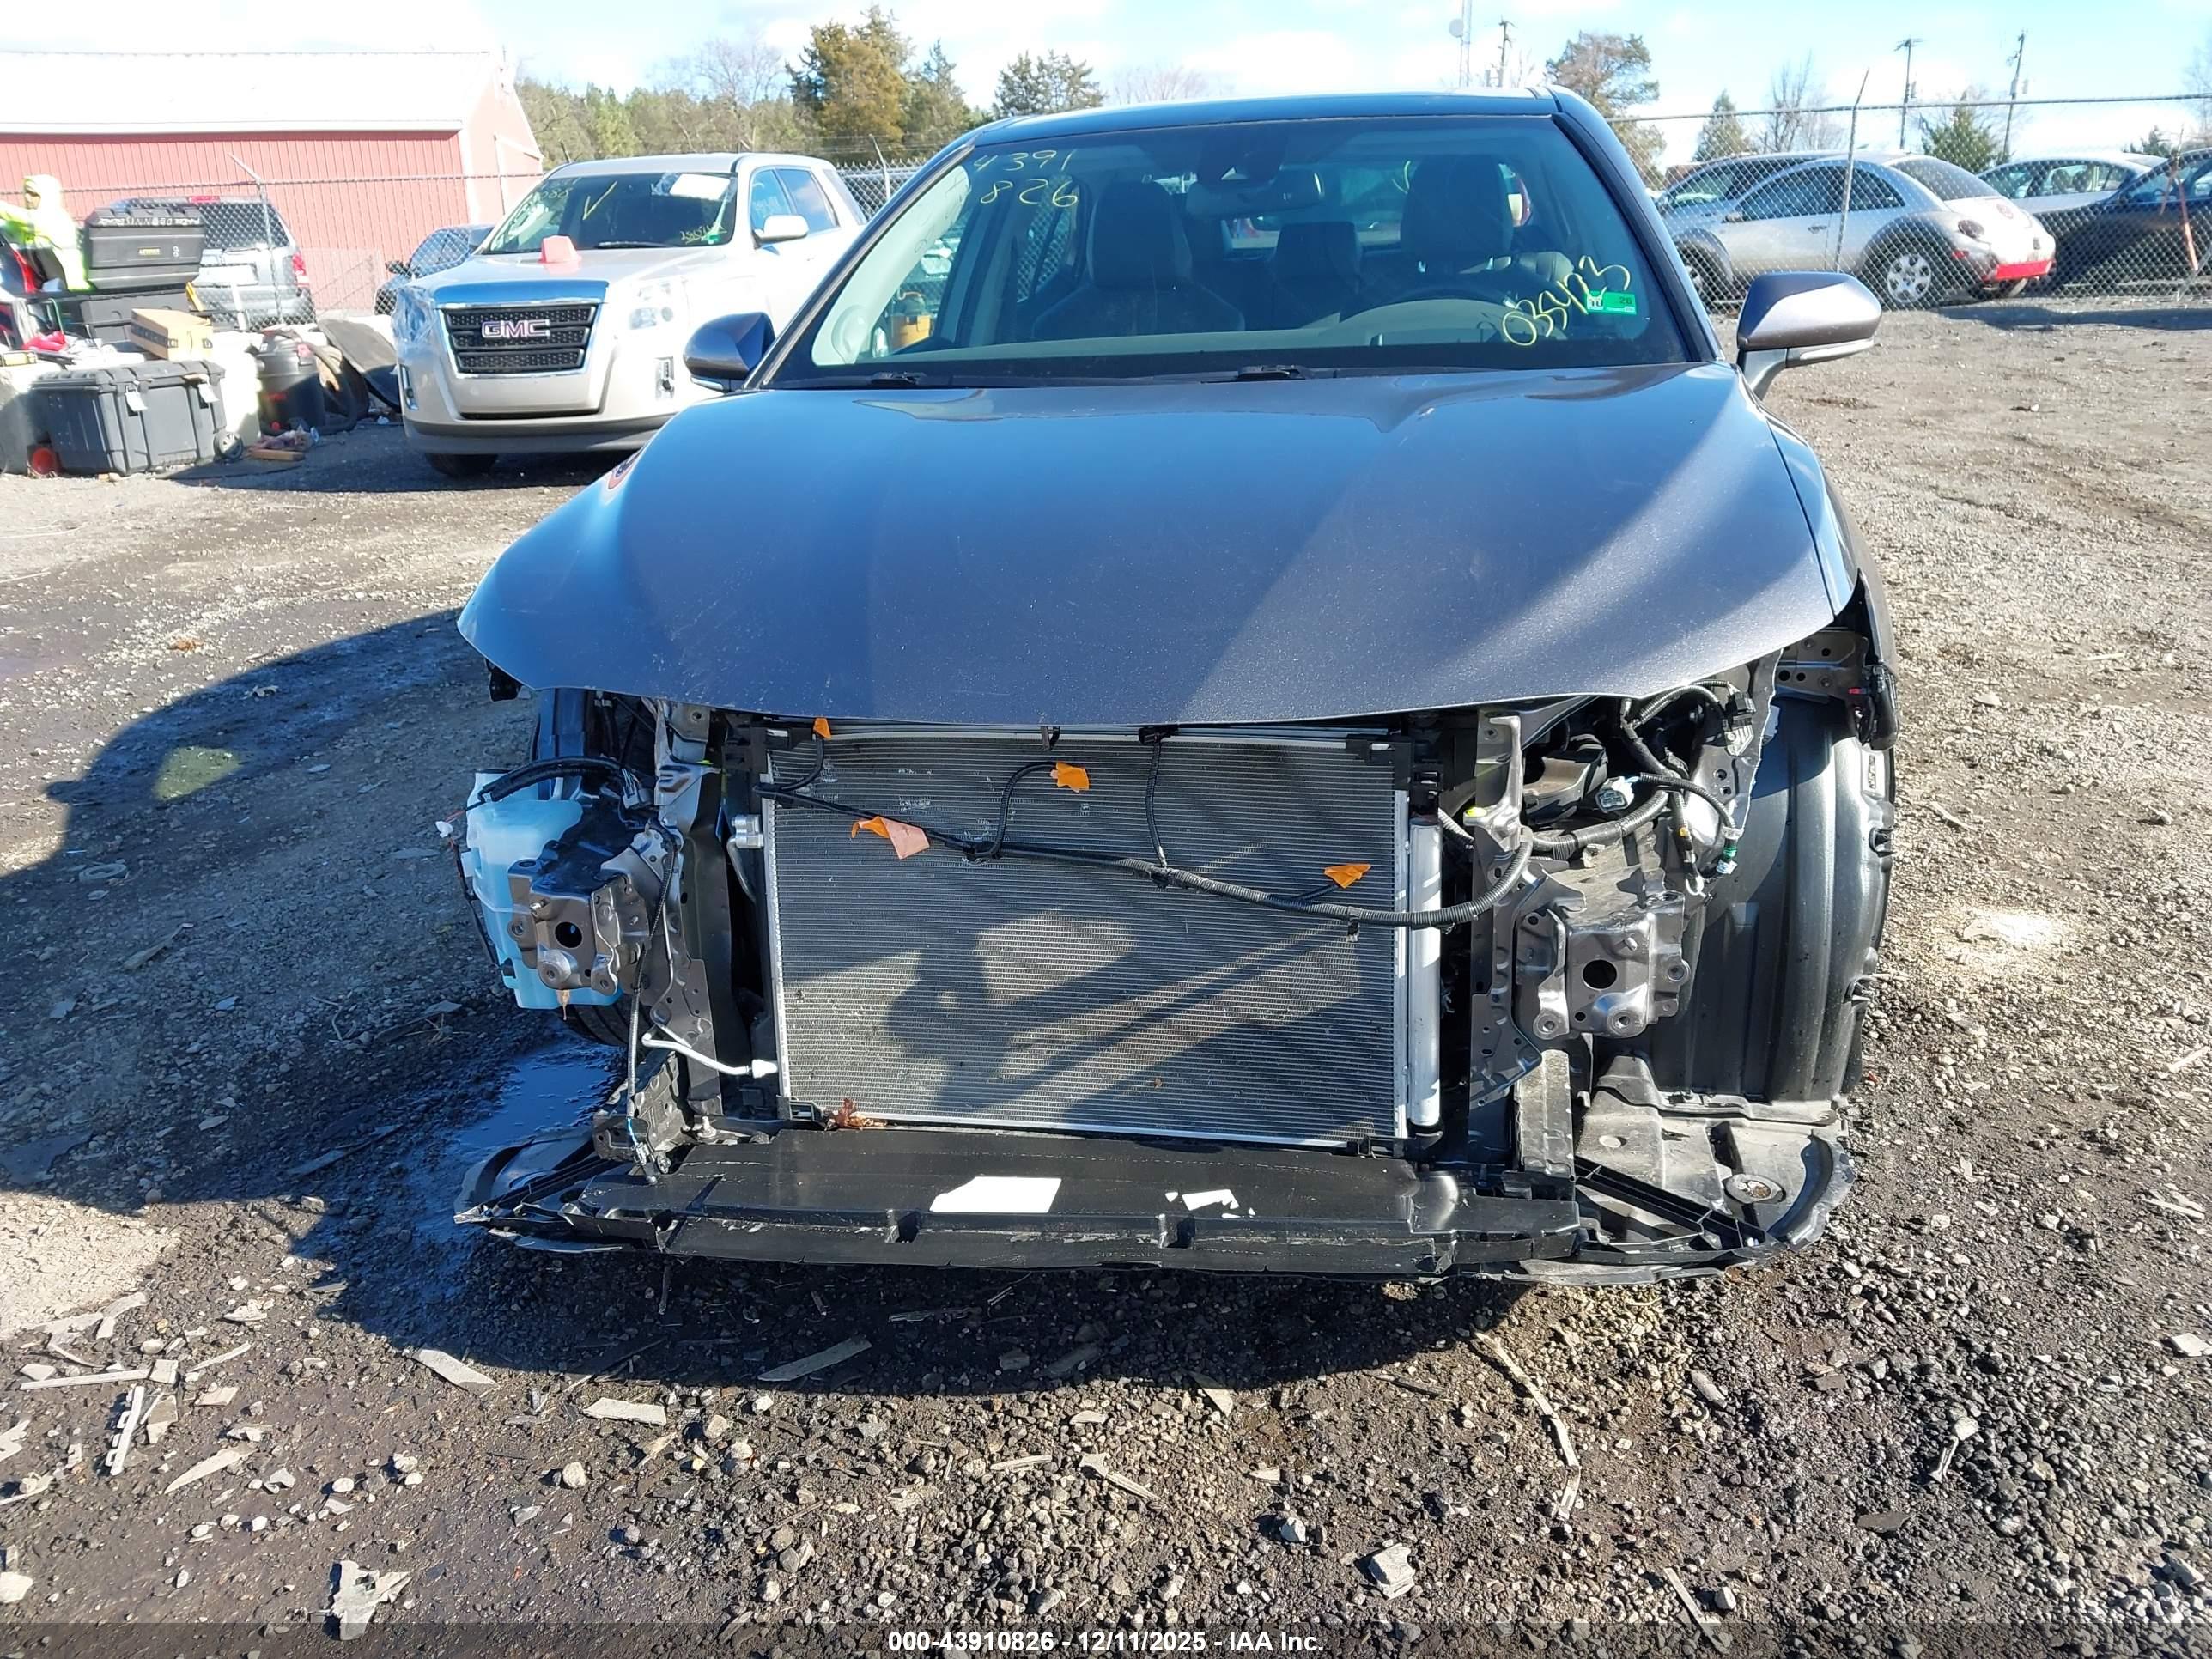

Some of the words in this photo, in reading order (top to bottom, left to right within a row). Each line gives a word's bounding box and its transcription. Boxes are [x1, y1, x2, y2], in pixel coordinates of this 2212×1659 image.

[974, 149, 1077, 171] 4391
[980, 178, 1078, 207] 826
[482, 319, 550, 338] GMC
